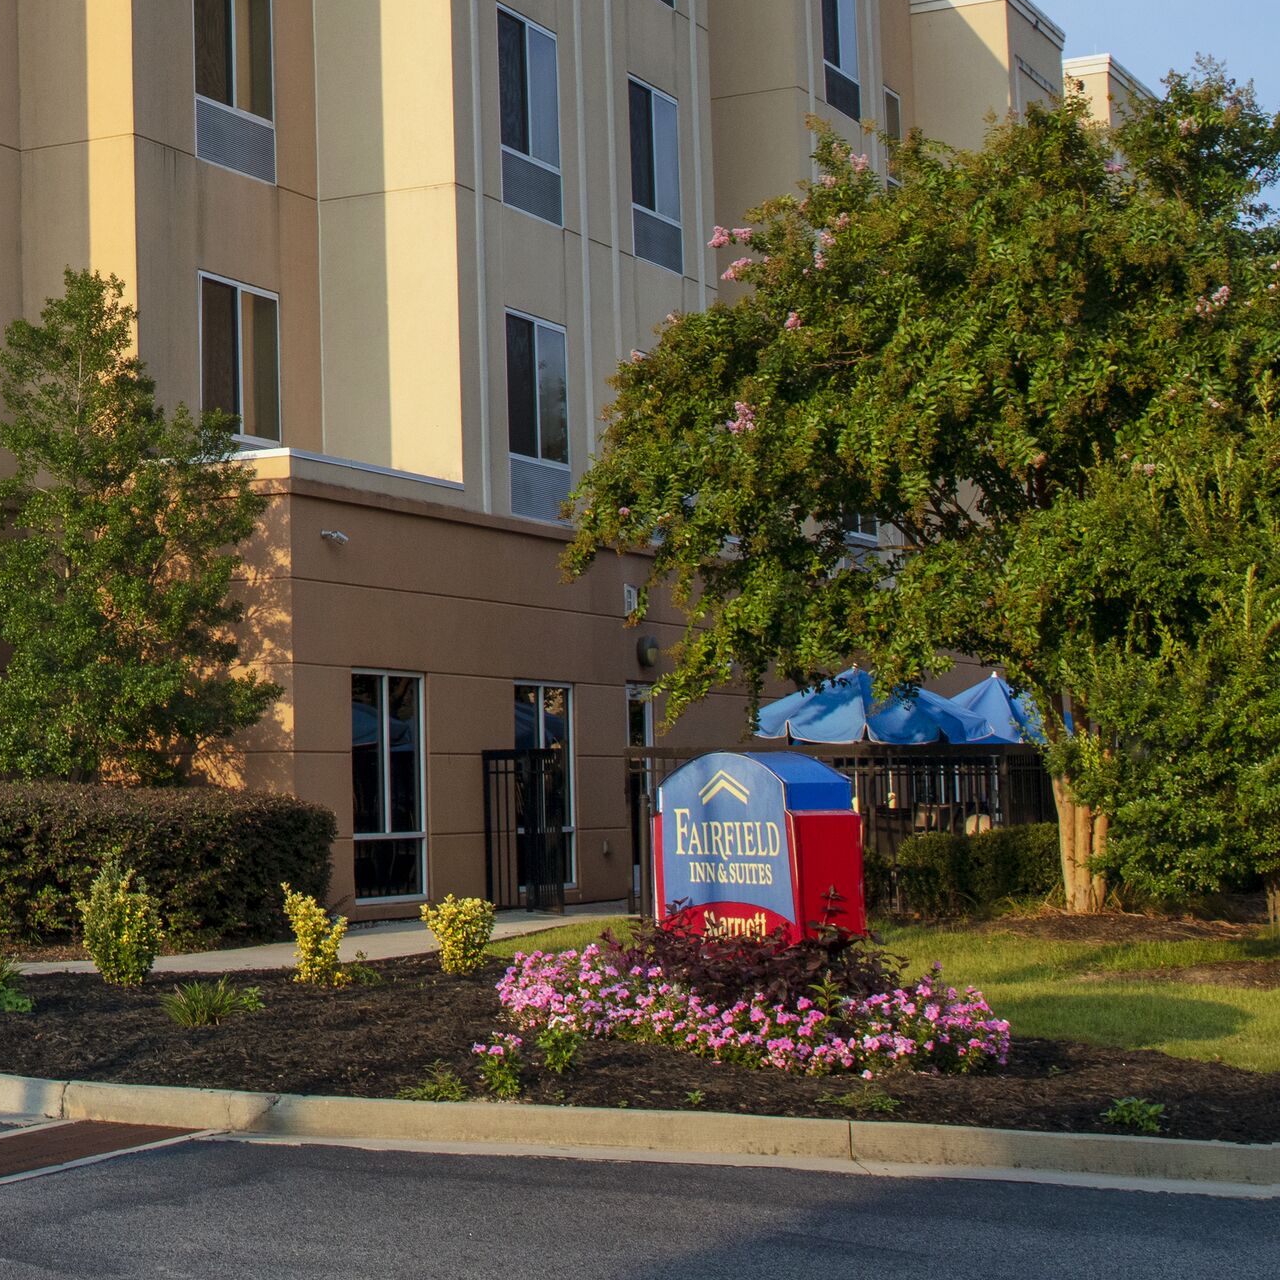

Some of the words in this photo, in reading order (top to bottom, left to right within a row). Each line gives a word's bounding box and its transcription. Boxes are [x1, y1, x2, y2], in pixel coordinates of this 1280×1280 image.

[673, 808, 781, 860] FAIRFIELD
[689, 862, 716, 883] INN
[717, 863, 729, 883] &
[729, 863, 773, 885] SUITES
